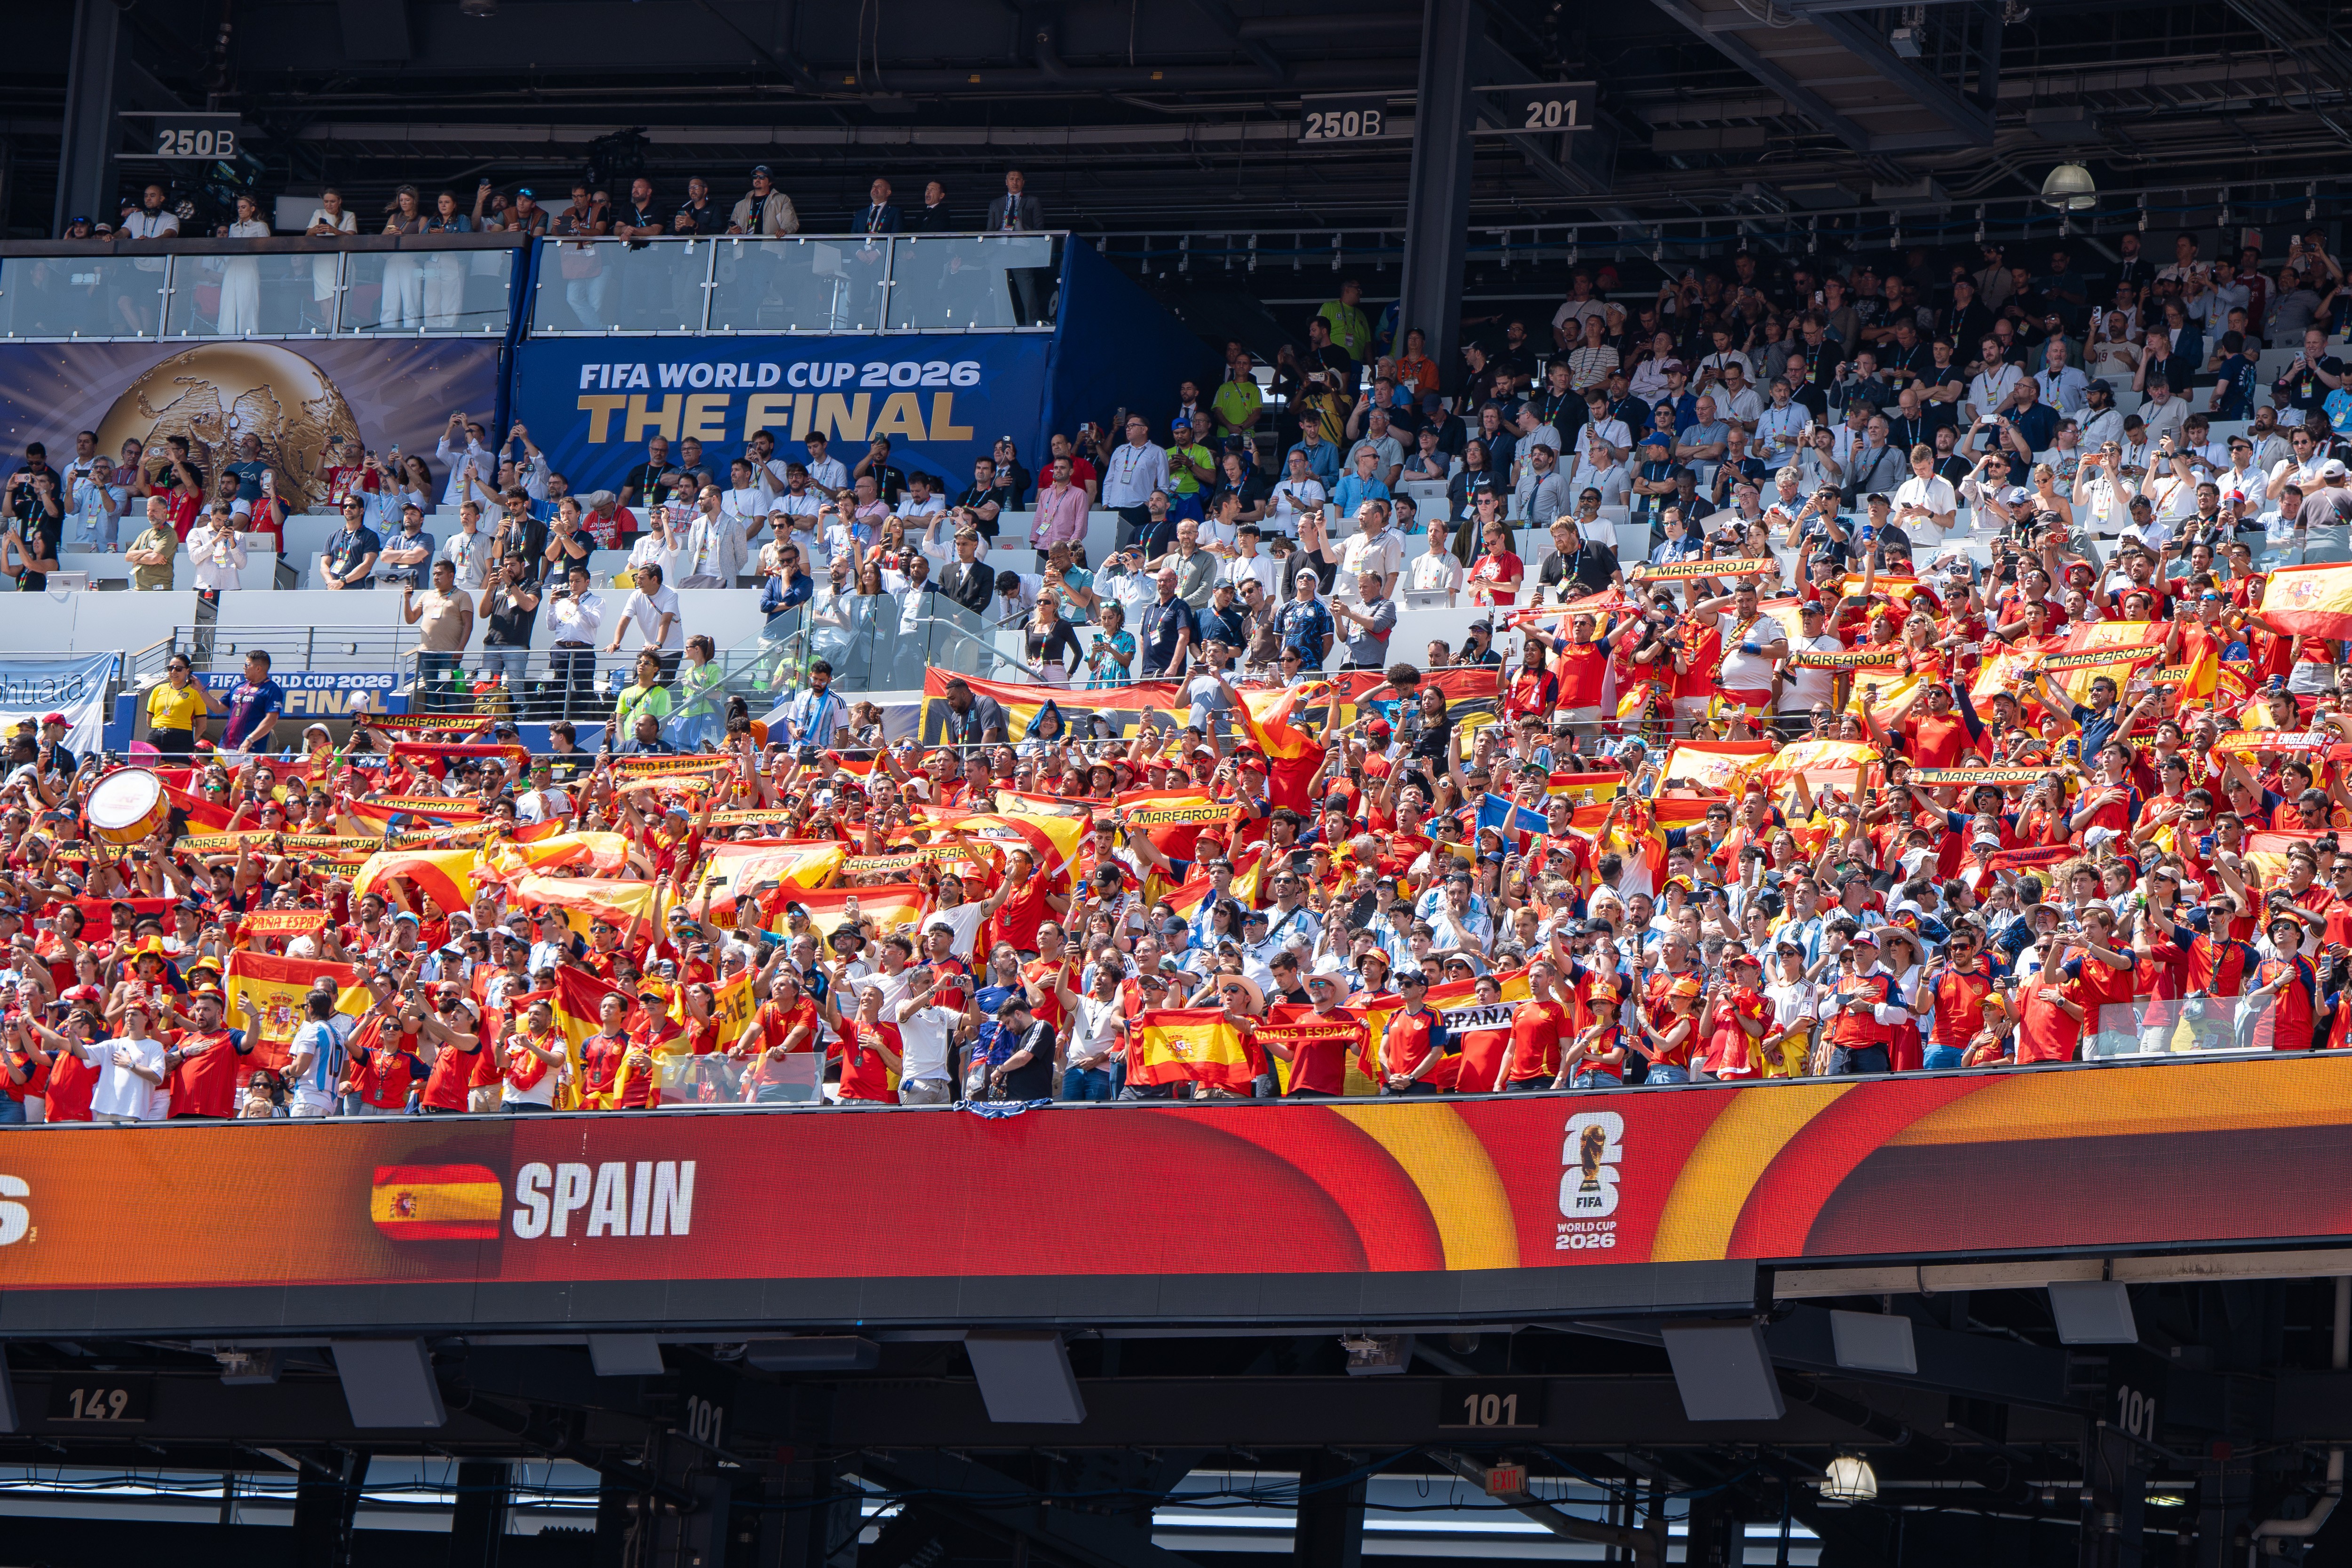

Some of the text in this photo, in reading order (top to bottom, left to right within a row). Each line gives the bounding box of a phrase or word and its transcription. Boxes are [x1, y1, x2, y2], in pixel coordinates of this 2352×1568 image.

[1526, 100, 1576, 127] 201
[1306, 111, 1380, 138] 250B
[158, 130, 233, 155] 250B
[2098, 351, 2107, 362] 19
[580, 361, 980, 388] FIFA WORLD CUP 2026
[577, 392, 974, 443] THE FINAL
[1657, 561, 1755, 576] MAREAROJA
[1798, 653, 1895, 665] MAREAROJA
[2058, 647, 2153, 666] MAREAROJA
[2227, 646, 2239, 661] ULTRA
[209, 676, 392, 687] FIFA RLD CUP 2026
[0, 674, 85, 706] huaia
[383, 715, 476, 729] MAREAROJA
[2128, 733, 2190, 746] ESPAA
[2220, 732, 2326, 747] ESPAÑA ENGLAND
[629, 762, 656, 772] ESTO
[659, 761, 670, 770] ES
[1936, 771, 2036, 781] MAREAROJA
[673, 779, 704, 789] ROJA
[373, 799, 465, 812] MAREAROJA
[2151, 803, 2162, 817] 10
[746, 813, 781, 822] ROJA
[1138, 807, 1229, 823] MAREAROJA
[399, 823, 493, 845] MAREAROJA
[184, 837, 227, 848] MAREA
[340, 839, 375, 849] ROJA
[919, 845, 993, 858] AREAROJA
[244, 915, 282, 929] SPAÑA
[1445, 1005, 1512, 1029] SPAÑA
[1254, 1024, 1357, 1040] VAMOS ESPAÑA
[330, 1043, 342, 1078] 10
[1975, 1050, 1984, 1060] 19
[513, 1161, 696, 1239] SPAIN
[1576, 1197, 1602, 1209] FIFA
[1557, 1221, 1617, 1233] WORLD CUP
[1556, 1233, 1616, 1250] 2026
[70, 1389, 128, 1419] 149
[1464, 1394, 1517, 1425] 101
[2117, 1385, 2155, 1442] 101
[686, 1395, 723, 1448] 101
[1493, 1470, 1517, 1490] EXIT
